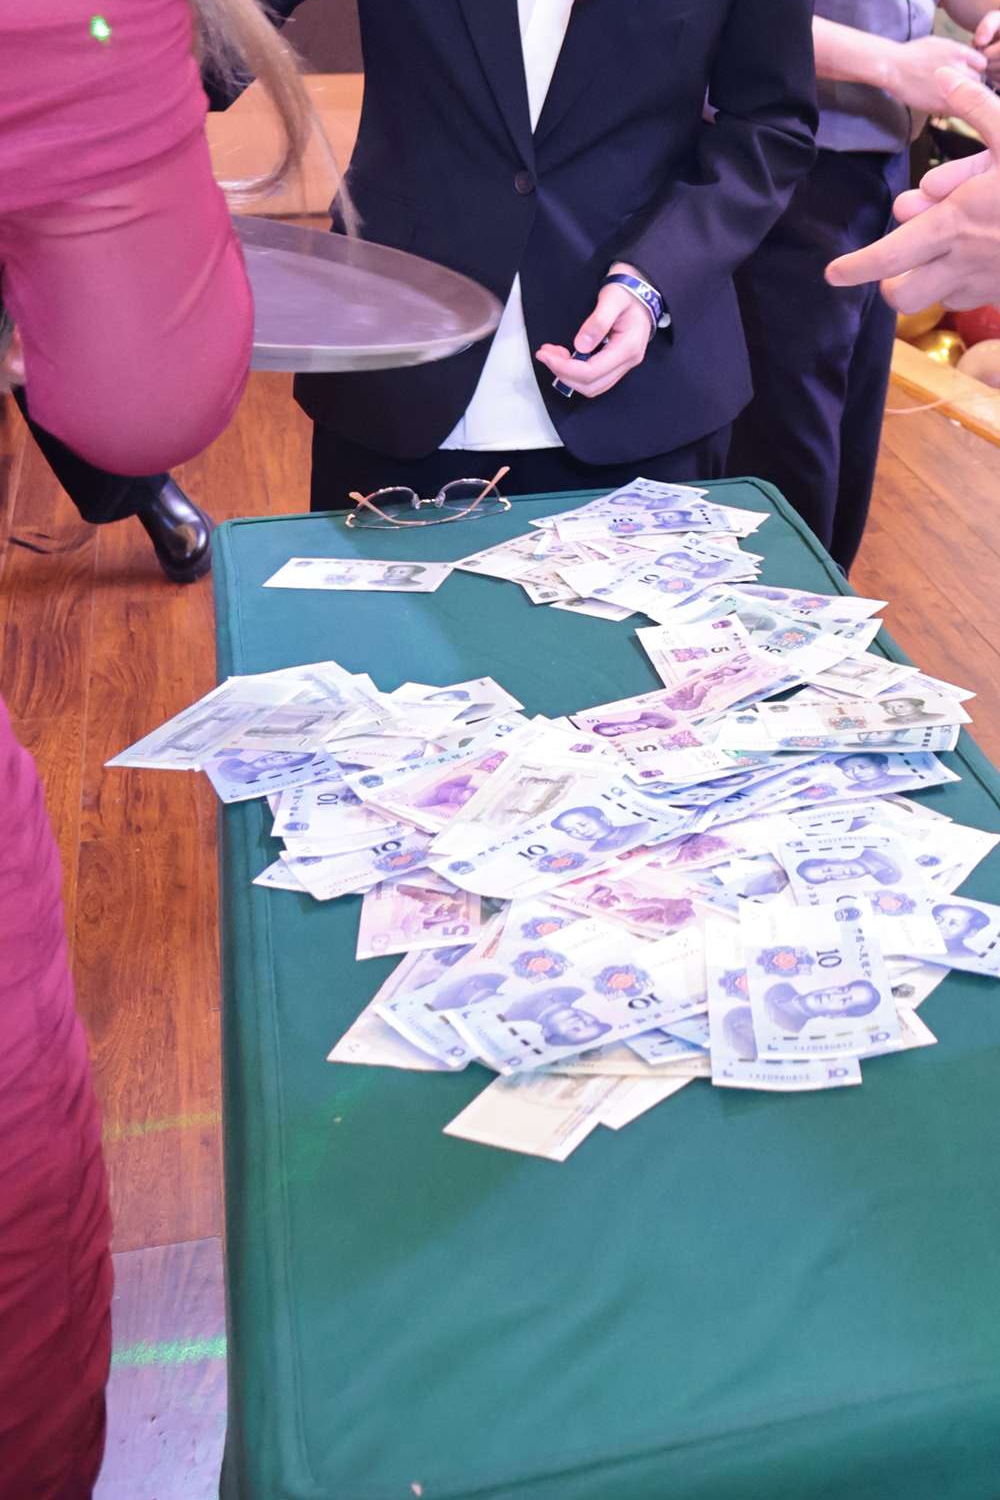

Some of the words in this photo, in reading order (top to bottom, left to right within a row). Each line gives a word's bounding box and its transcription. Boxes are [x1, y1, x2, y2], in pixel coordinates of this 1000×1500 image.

[638, 573, 660, 585] 10
[711, 646, 730, 654] 5
[636, 744, 659, 753] 5
[317, 793, 339, 806] 10
[371, 839, 402, 855] 10
[517, 844, 549, 861] 10
[442, 924, 470, 937] 5
[816, 948, 843, 968] 10
[627, 992, 662, 1010] 10
[869, 1031, 891, 1044] 10
[828, 1067, 849, 1080] 10
